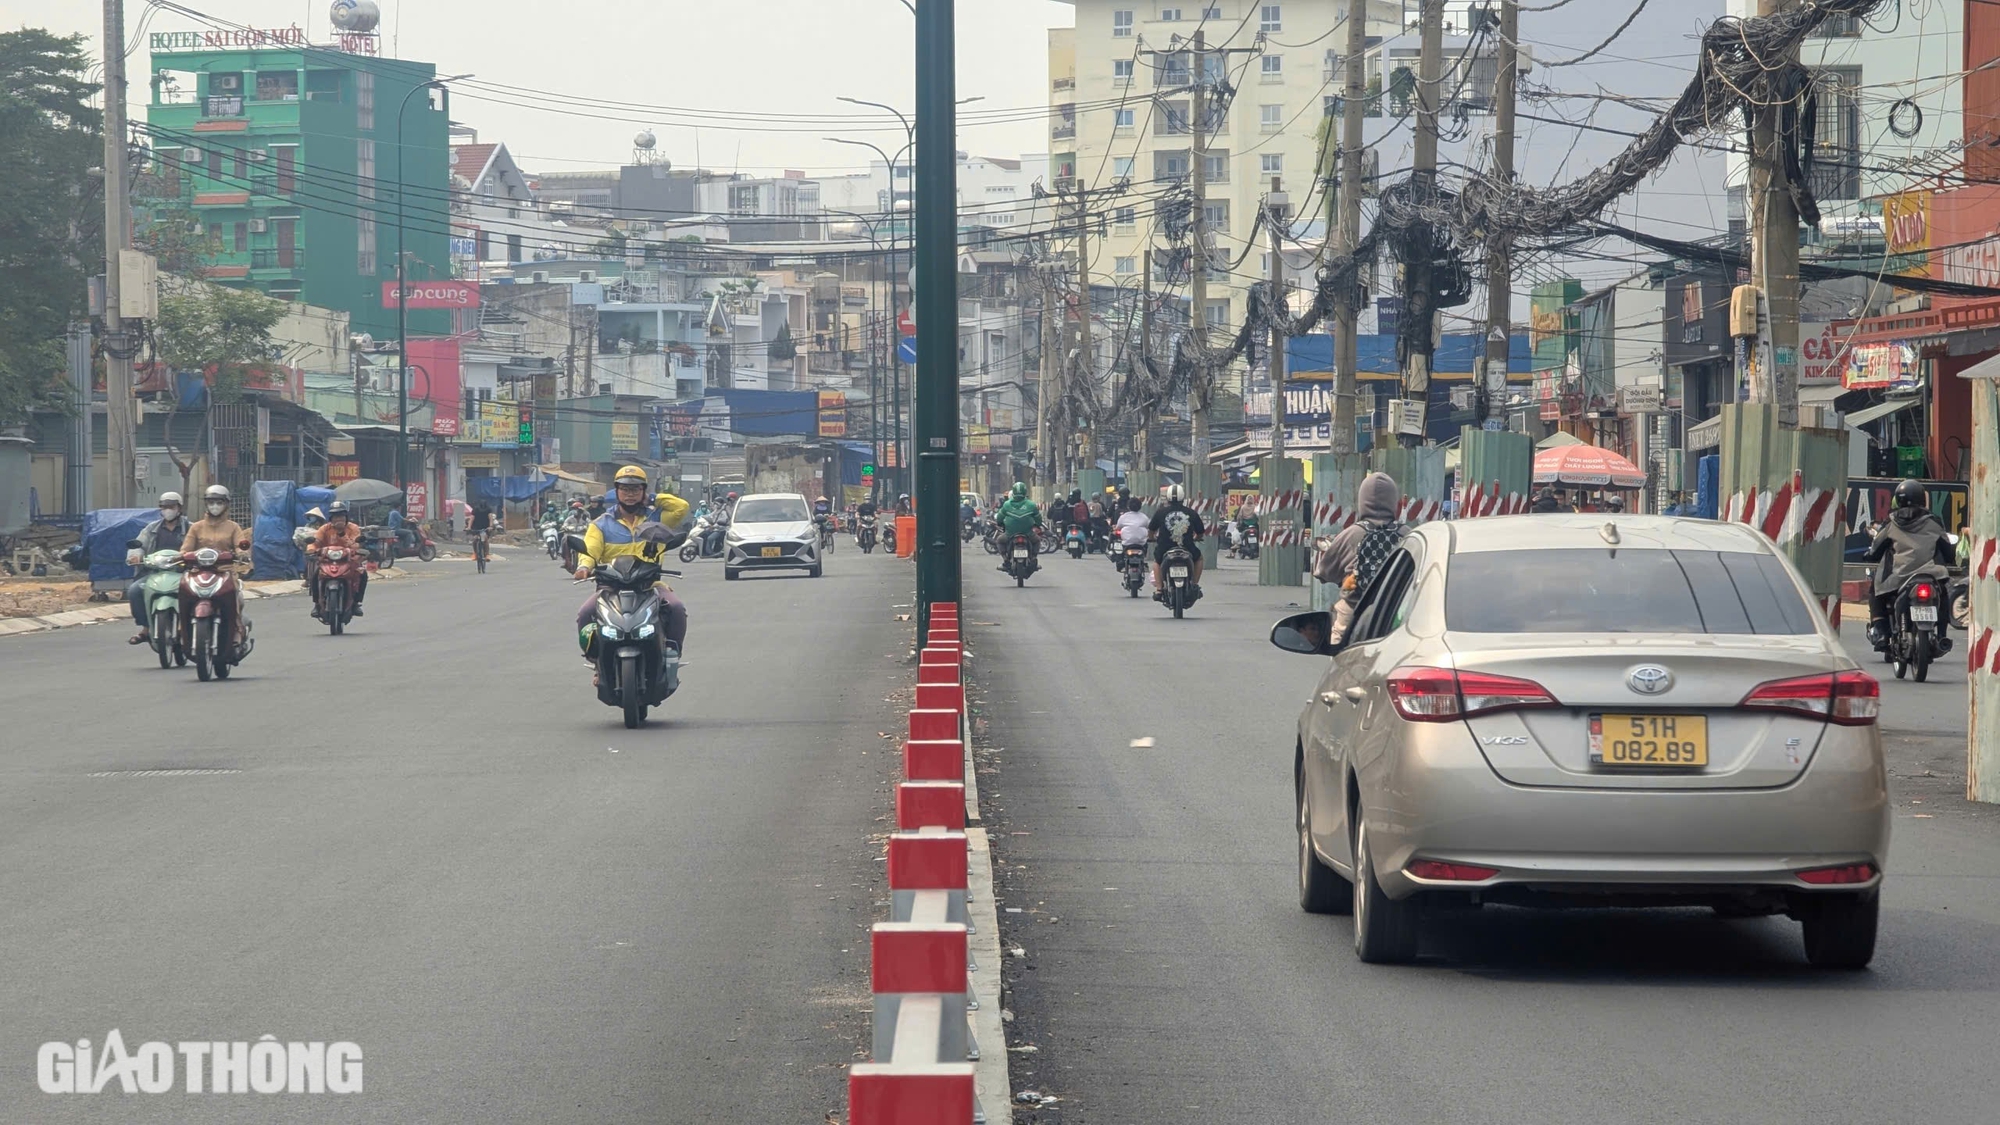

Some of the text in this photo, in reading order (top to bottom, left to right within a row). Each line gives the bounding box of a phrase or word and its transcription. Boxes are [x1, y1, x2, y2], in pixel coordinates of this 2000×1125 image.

[150, 31, 202, 48] HOTEL
[234, 25, 267, 46] GÒN
[271, 22, 301, 45] MỚI
[340, 34, 376, 53] HOTEL
[1804, 365, 1823, 378] KIM
[1283, 384, 1333, 418] HUẬN
[407, 484, 425, 495] ỬA
[1631, 717, 1676, 738] 51H
[1613, 740, 1696, 762] 082.89
